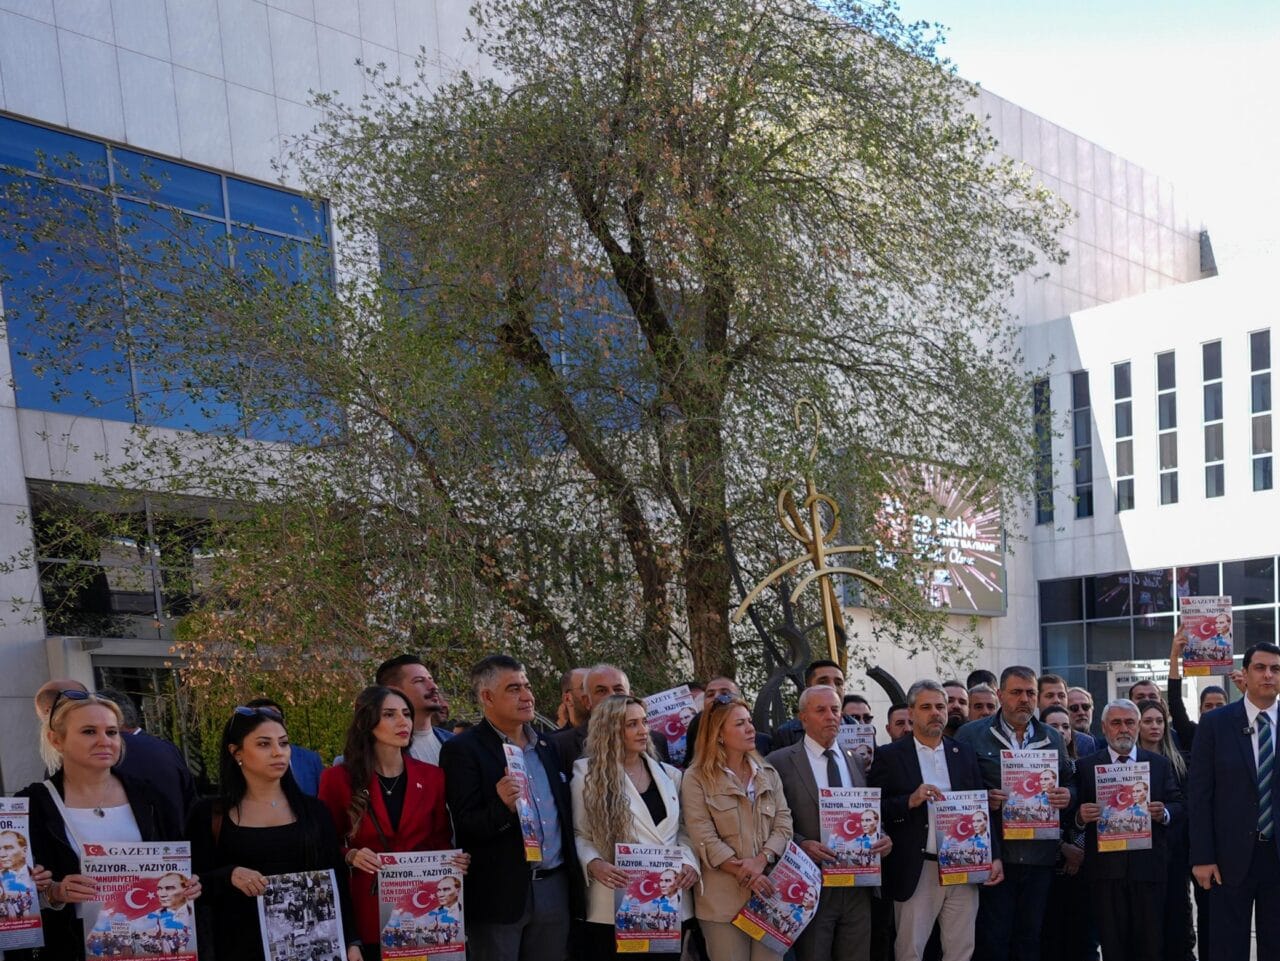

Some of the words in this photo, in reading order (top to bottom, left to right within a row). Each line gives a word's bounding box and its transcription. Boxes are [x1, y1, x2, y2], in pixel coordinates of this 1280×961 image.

[935, 516, 976, 538] EKİM
[109, 847, 160, 856] GAZETE
[400, 855, 439, 864] GAZETE
